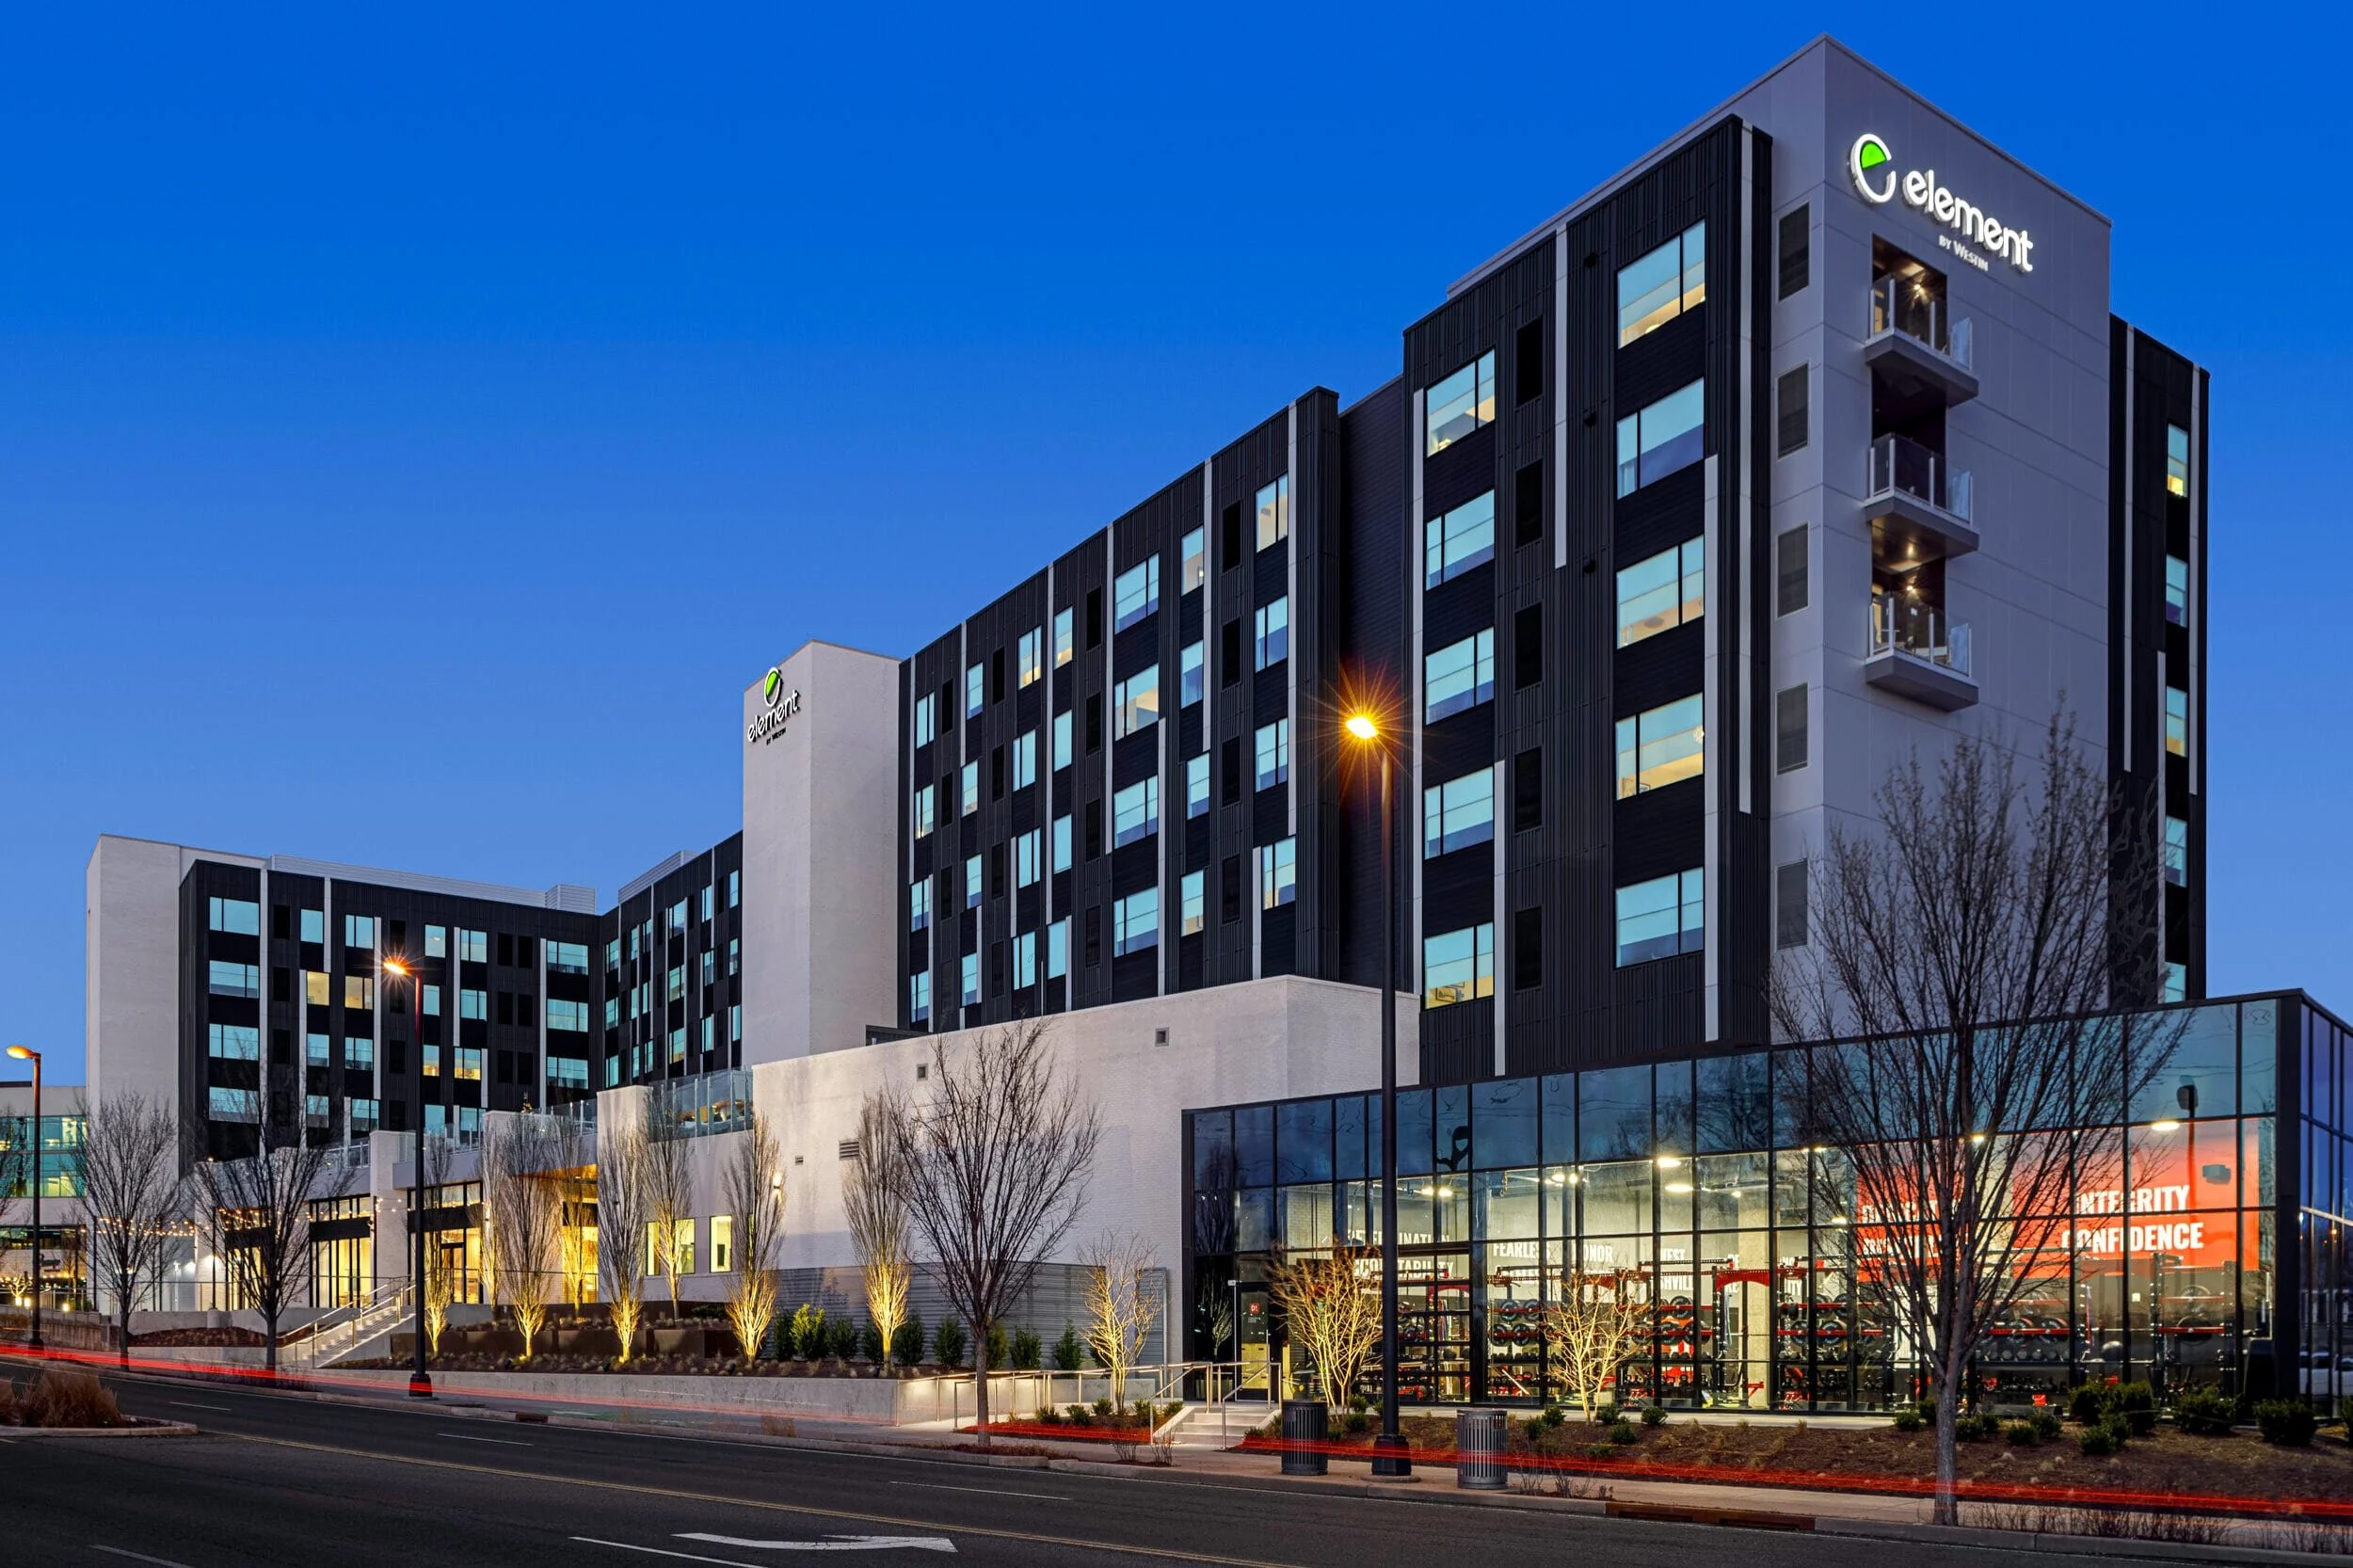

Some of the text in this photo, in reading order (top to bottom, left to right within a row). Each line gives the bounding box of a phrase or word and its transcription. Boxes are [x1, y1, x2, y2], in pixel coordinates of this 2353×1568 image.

[1902, 169, 2034, 273] element
[747, 689, 798, 743] element
[1575, 1243, 1613, 1263] ONOR
